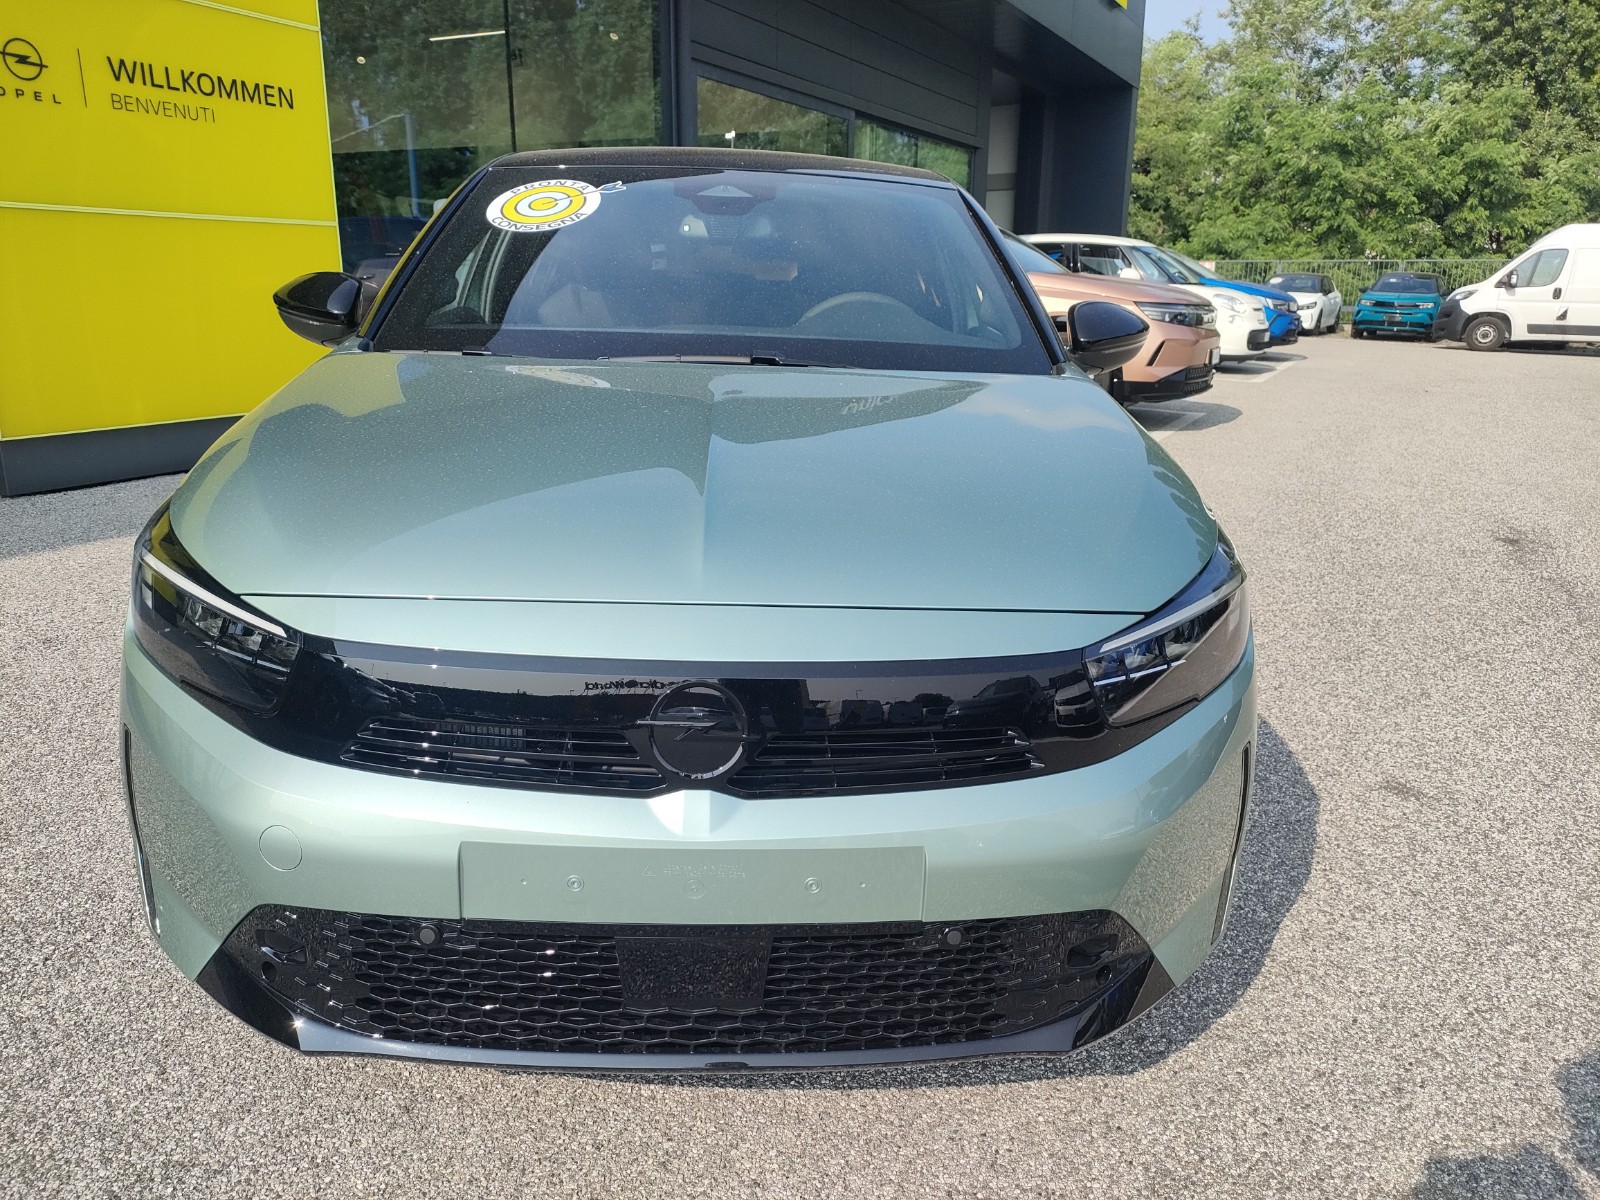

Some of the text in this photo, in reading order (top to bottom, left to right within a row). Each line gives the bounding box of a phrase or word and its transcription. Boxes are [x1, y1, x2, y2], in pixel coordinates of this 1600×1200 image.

[106, 56, 294, 110] WILLKOMMEN
[110, 93, 216, 123] BENVENUTI
[511, 180, 590, 195] PRONTA
[491, 211, 588, 231] CONSEGNA
